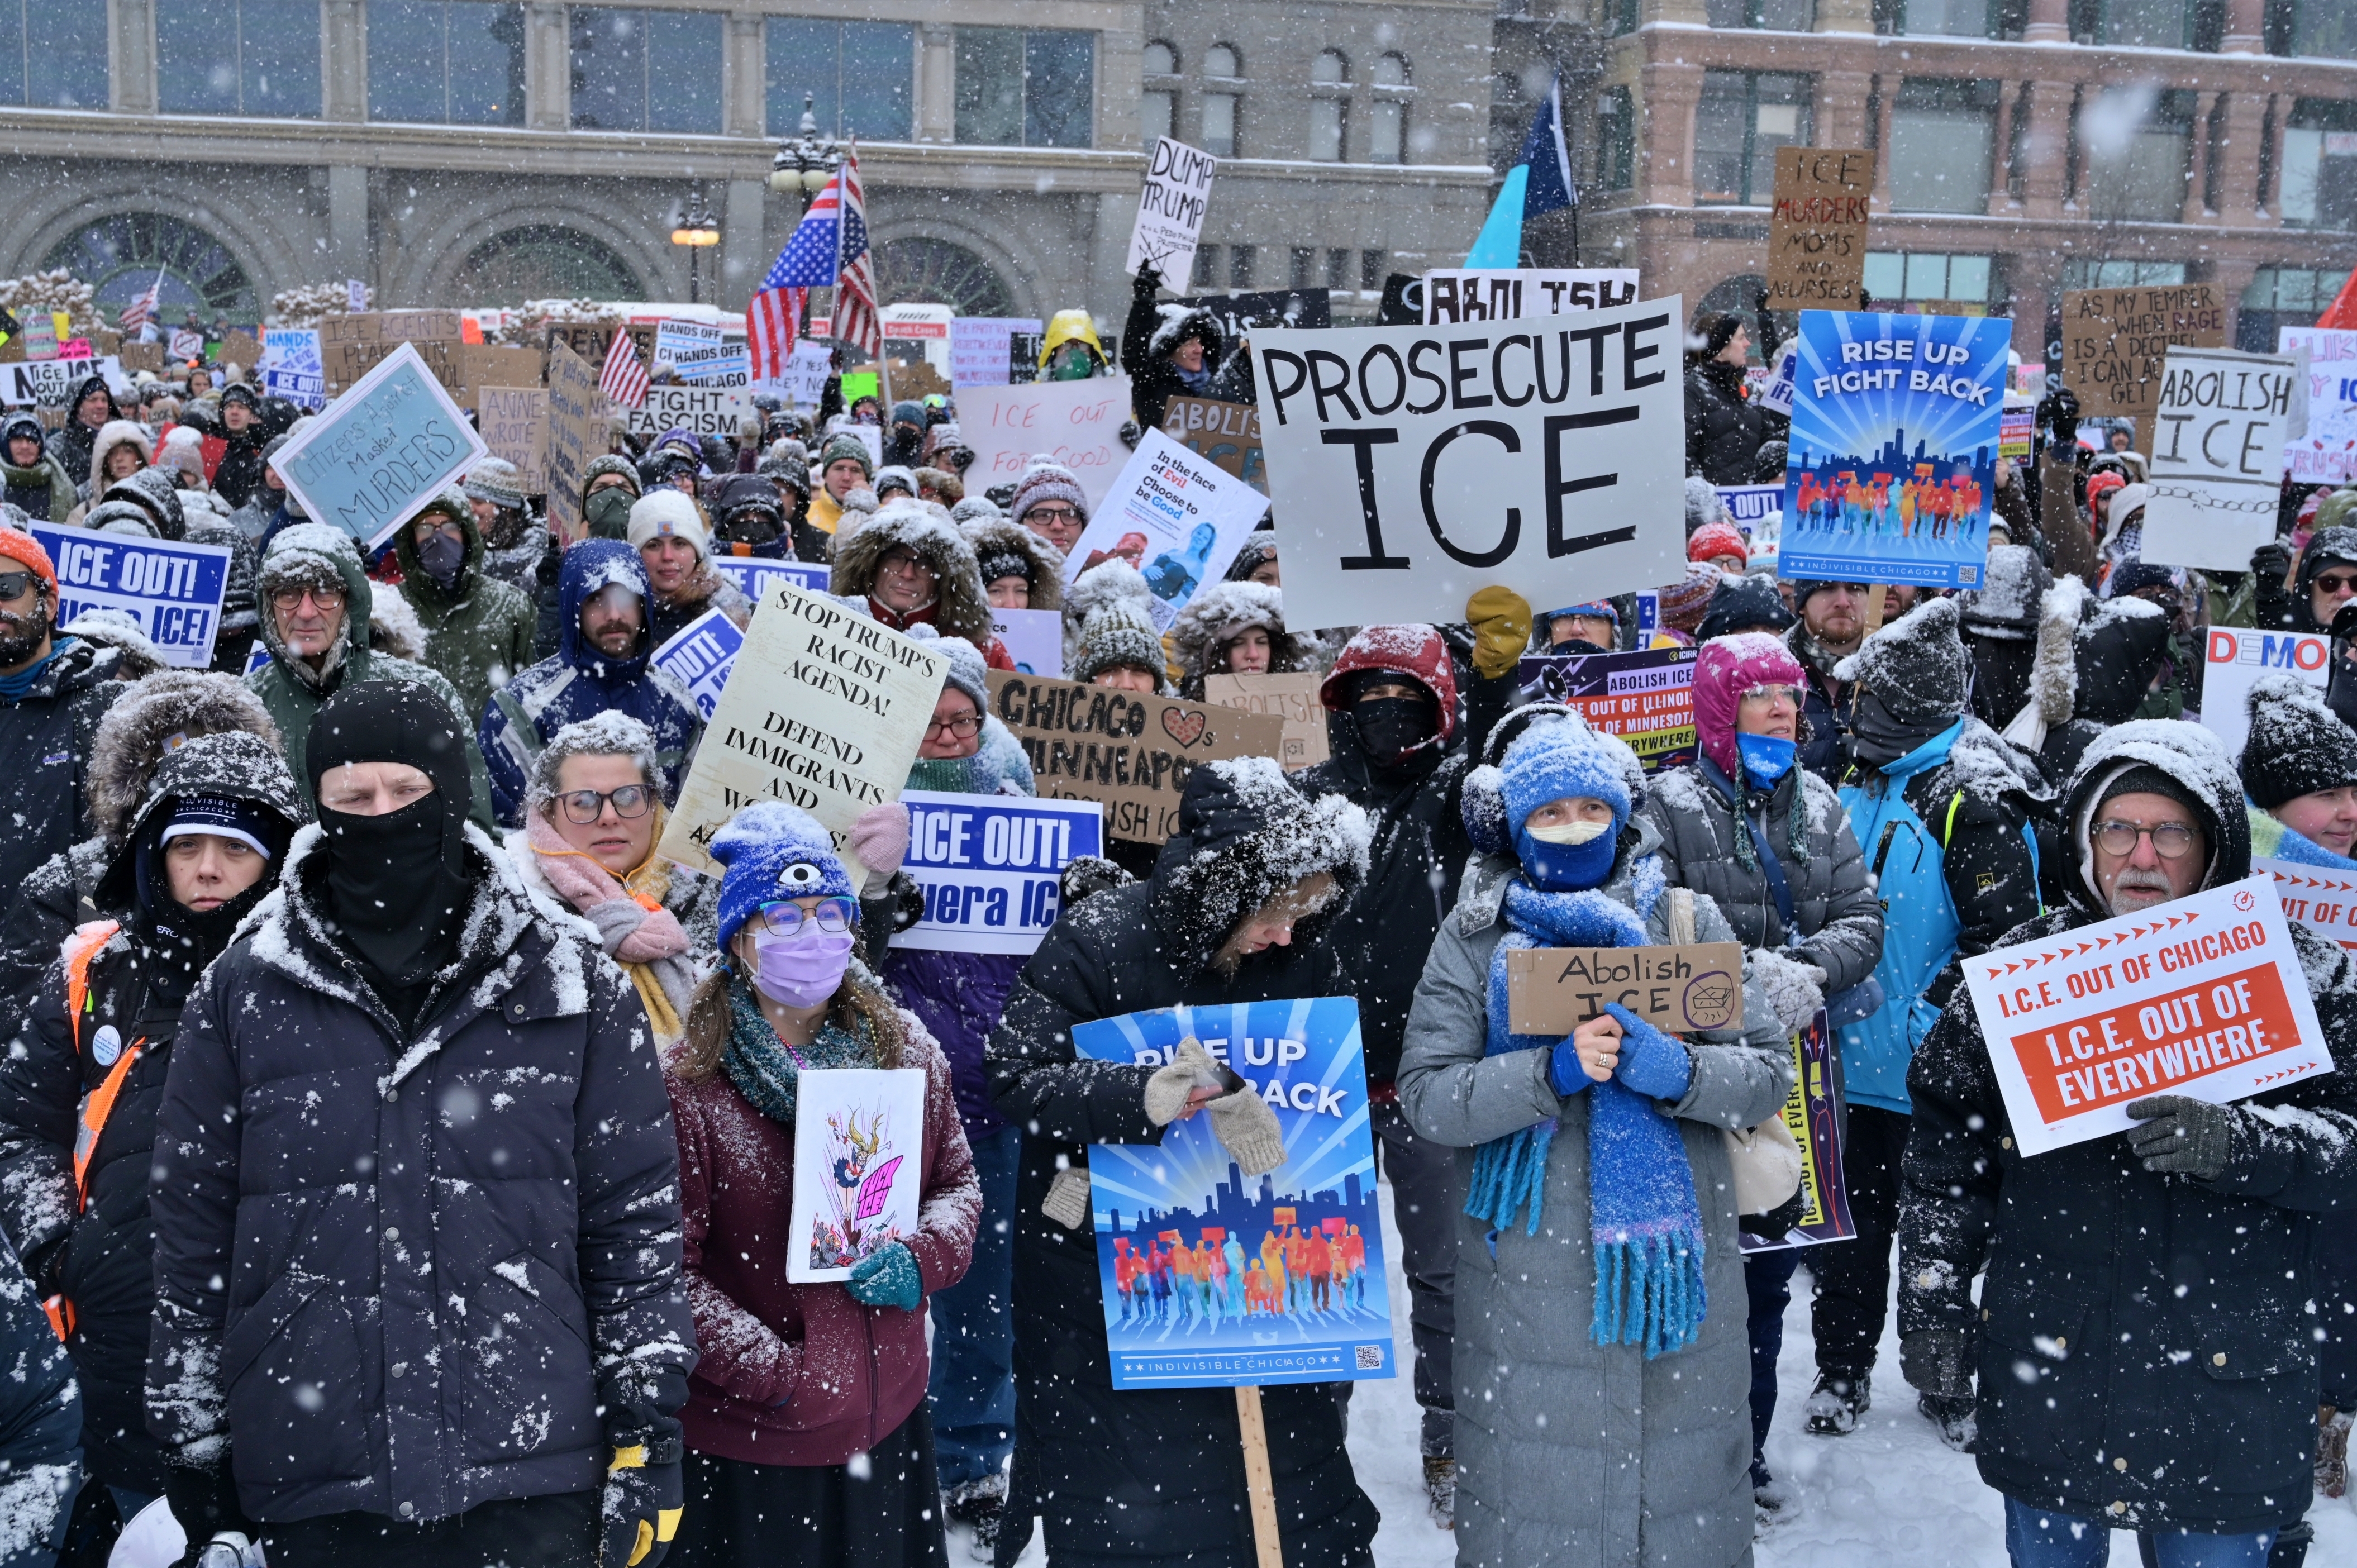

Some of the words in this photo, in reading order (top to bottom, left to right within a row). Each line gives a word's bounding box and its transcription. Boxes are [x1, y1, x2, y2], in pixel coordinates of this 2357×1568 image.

[1150, 140, 1215, 190] DUMP
[1797, 154, 1864, 186] ICE
[1143, 180, 1205, 230] TRUMP
[1772, 196, 1870, 224] MURDERS
[1156, 236, 1193, 252] PROTECTOR
[1783, 232, 1854, 256] MOMS
[1797, 261, 1831, 275] AND
[1766, 279, 1860, 300] NURSES
[2113, 293, 2136, 314] MY
[2146, 287, 2214, 312] TEMPER
[326, 319, 370, 342] ICE
[378, 314, 458, 339] AGENTS
[661, 322, 698, 337] HANDS
[701, 328, 721, 340] OFF
[2113, 313, 2165, 335] WHEN
[2173, 309, 2223, 332] RAGE
[266, 333, 313, 347] HANDS
[674, 347, 717, 364] HANDS
[720, 345, 743, 357] OFF
[1841, 340, 1914, 364] RISE
[1924, 342, 1970, 366] UP
[2073, 337, 2096, 359] IS
[2103, 338, 2117, 358] A
[2306, 333, 2357, 362] LIK
[36, 369, 63, 380] ICE
[277, 373, 296, 390] ICE
[689, 372, 746, 388] HICAGO
[1261, 313, 1670, 426] PROSECUTE
[2078, 362, 2088, 384] I
[2094, 359, 2132, 383] CAN
[36, 382, 65, 393] OUT
[645, 391, 723, 412] FIGHT
[1813, 368, 1902, 399] FIGHT
[1908, 369, 1993, 407] BACK
[2111, 382, 2150, 404] GET
[2159, 369, 2292, 416] ABOLISH
[487, 392, 542, 419] ANNE
[992, 403, 1041, 428] ICE
[1069, 399, 1116, 425] OUT
[1165, 402, 1263, 440] ABOLIS
[484, 422, 537, 444] WROTE
[628, 412, 737, 434] FASCISM
[293, 422, 365, 486] Citizens
[347, 427, 397, 475] Masked
[2155, 414, 2269, 475] ICE
[337, 420, 455, 535] MURDERS
[992, 451, 1031, 472] FOR
[1151, 463, 1166, 475] of
[1163, 469, 1188, 489] Evil
[1157, 450, 1170, 464] In
[1170, 459, 1191, 477] the
[1191, 471, 1217, 493] face
[1135, 485, 1151, 501] be
[1151, 495, 1184, 521] Good
[1142, 476, 1185, 507] Choose
[1185, 502, 1198, 515] to
[1320, 405, 1640, 571] ICE
[56, 540, 113, 588] ICE
[120, 551, 198, 599] OUT!
[1807, 561, 1876, 574] INDIVISIBLE
[1880, 565, 1931, 576] CHICAGO
[151, 605, 211, 647] ICE!
[775, 590, 841, 632] STOP
[843, 616, 936, 678] TRUMP'S
[660, 629, 726, 688] OUT!
[805, 633, 891, 685] RACIST
[1679, 650, 1698, 660] ICIRR
[2207, 631, 2331, 671] DEMO
[782, 659, 892, 717] AGENDA!
[1610, 671, 1666, 692] ABOLISH
[1672, 668, 1694, 684] ICE
[997, 679, 1146, 738] CHICAGO
[1589, 700, 1616, 716] OUT
[1622, 698, 1638, 713] OF
[1605, 720, 1622, 734] OF
[1626, 711, 1695, 733] MINNESOTA
[763, 710, 863, 766] DEFEND
[724, 727, 885, 807] IMMIGRANTS
[1020, 736, 1198, 794] INNEAPO
[179, 798, 238, 809] NDIVISIBLE
[762, 776, 818, 809] AND
[911, 811, 973, 864] ICE
[983, 814, 1070, 869] OUT!
[919, 881, 1009, 927] uera
[1019, 879, 1061, 928] IC
[2281, 897, 2309, 921] UT
[2313, 902, 2342, 923] OF
[1557, 951, 1692, 986] Abolish
[1997, 980, 2062, 1018] I.C.E.
[2066, 966, 2116, 1000] OUT
[2122, 953, 2151, 983] OF
[2158, 921, 2267, 974] CHICAGO
[1574, 986, 1671, 1022] ICE
[2045, 1016, 2134, 1068] I.C.E.
[2137, 992, 2203, 1042] OUT
[2211, 978, 2254, 1020] OF
[1243, 1037, 1307, 1067] UP
[2055, 1018, 2272, 1108] EVERYWHERE
[1255, 1079, 1349, 1118] ACK
[857, 1155, 904, 1204] FUCK
[856, 1188, 889, 1221] ICE!
[1148, 1357, 1241, 1372] INDIVISIBLE
[1247, 1355, 1317, 1370] CHICAGO
